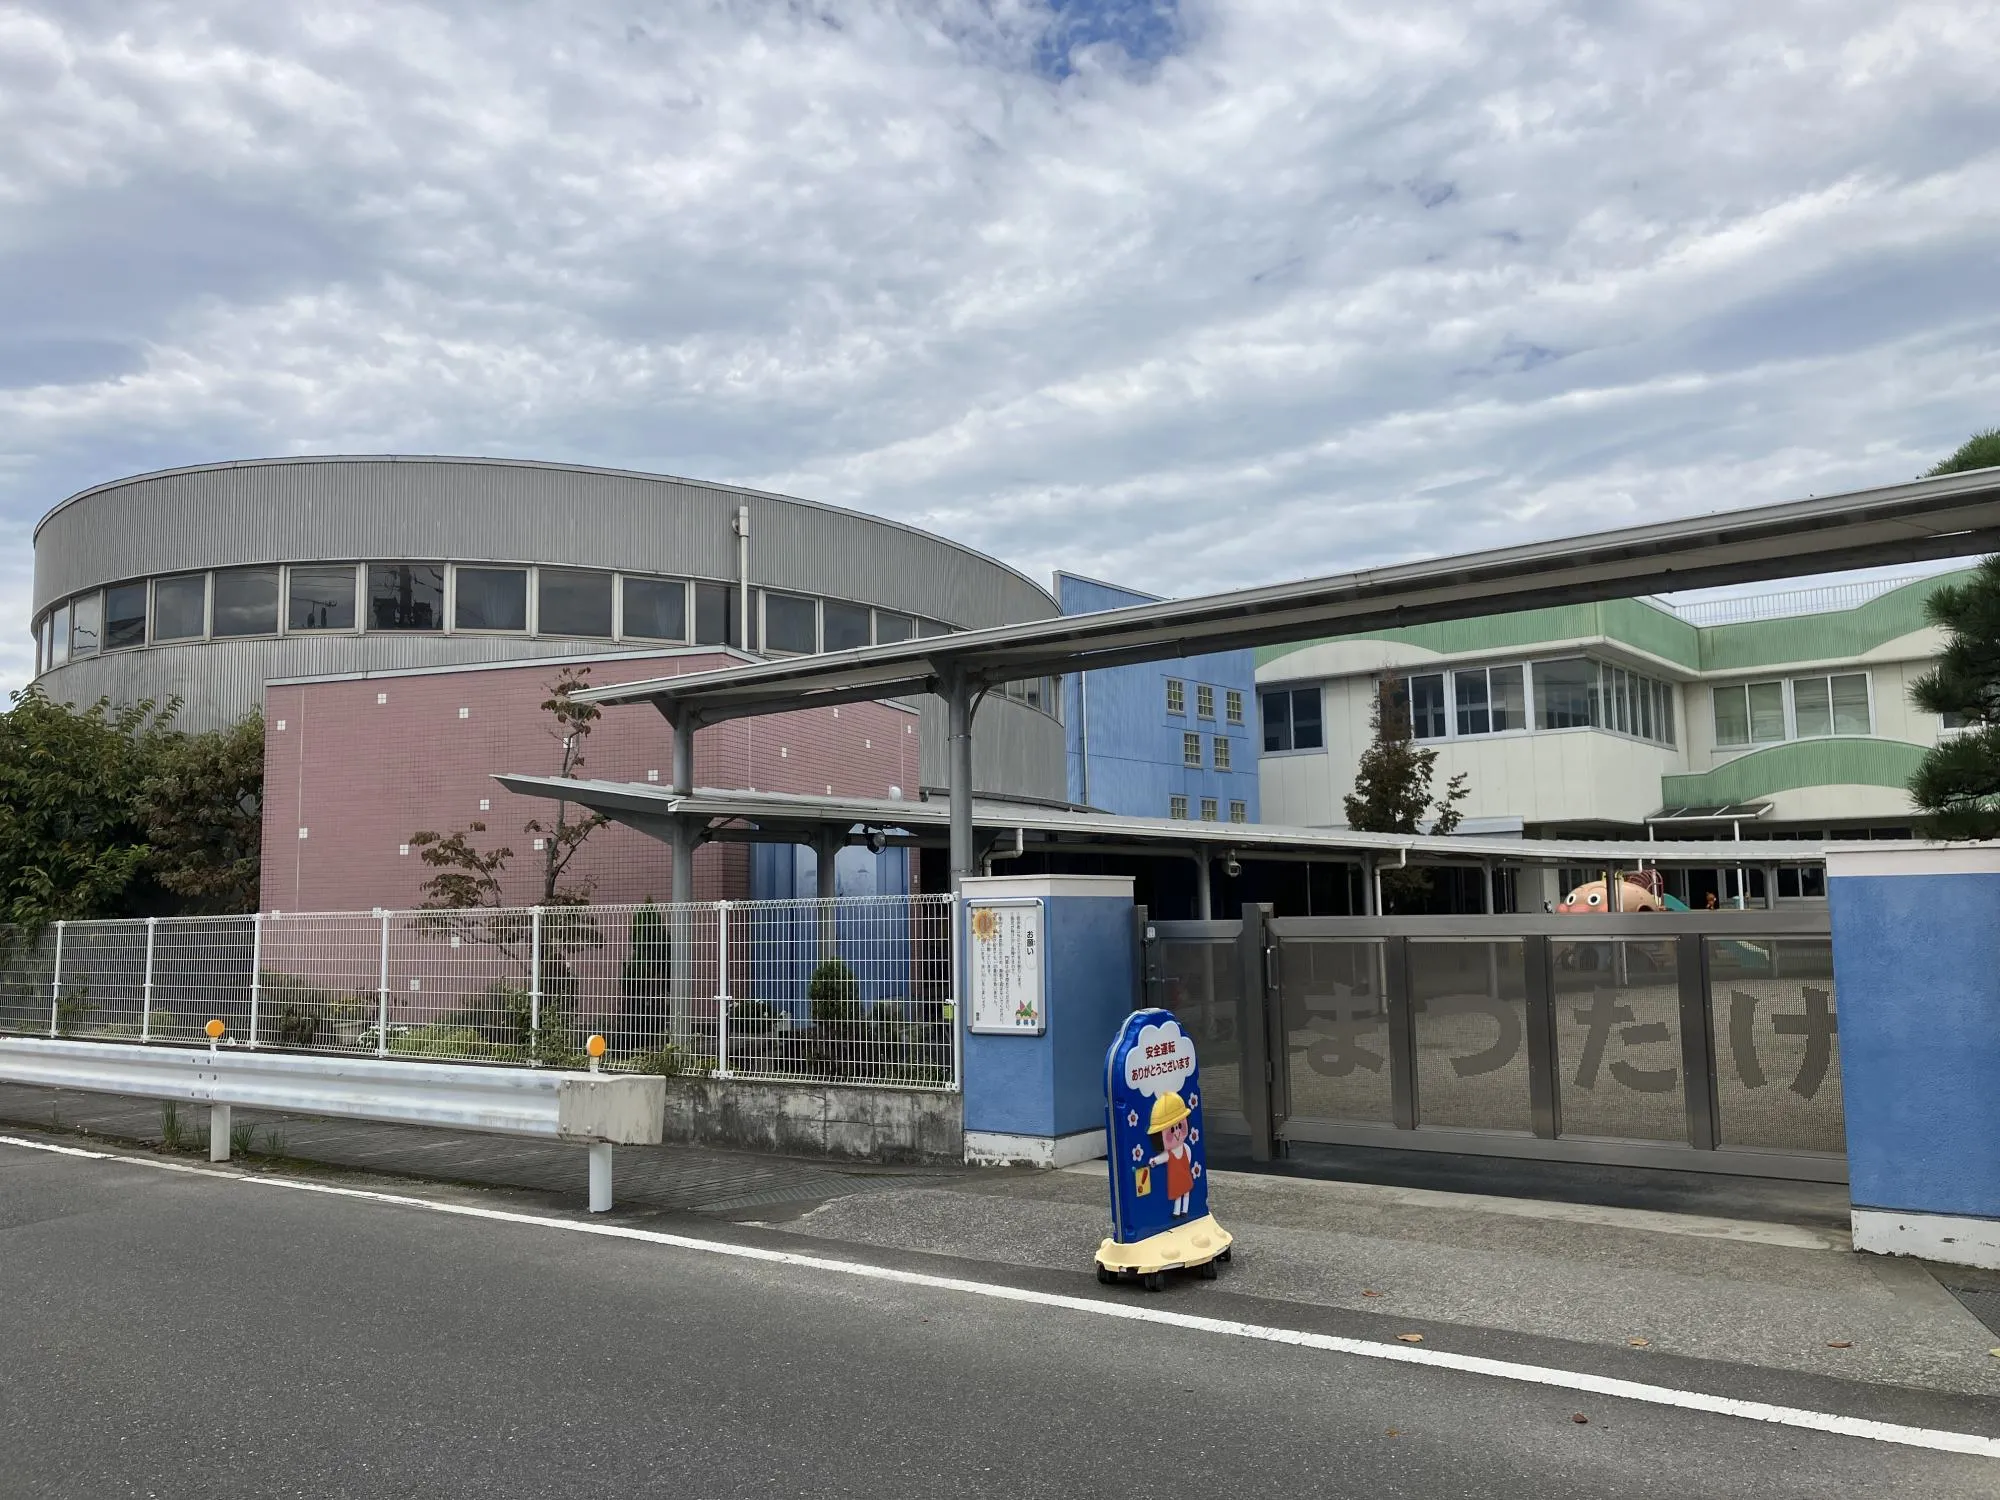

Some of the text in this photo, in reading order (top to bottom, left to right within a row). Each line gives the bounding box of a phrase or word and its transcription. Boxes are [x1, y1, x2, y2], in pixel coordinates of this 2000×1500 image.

[1145, 1041, 1176, 1059] 安全運転
[1305, 981, 1838, 1100] まつたけ
[1131, 1056, 1190, 1081] ありがとうございます
